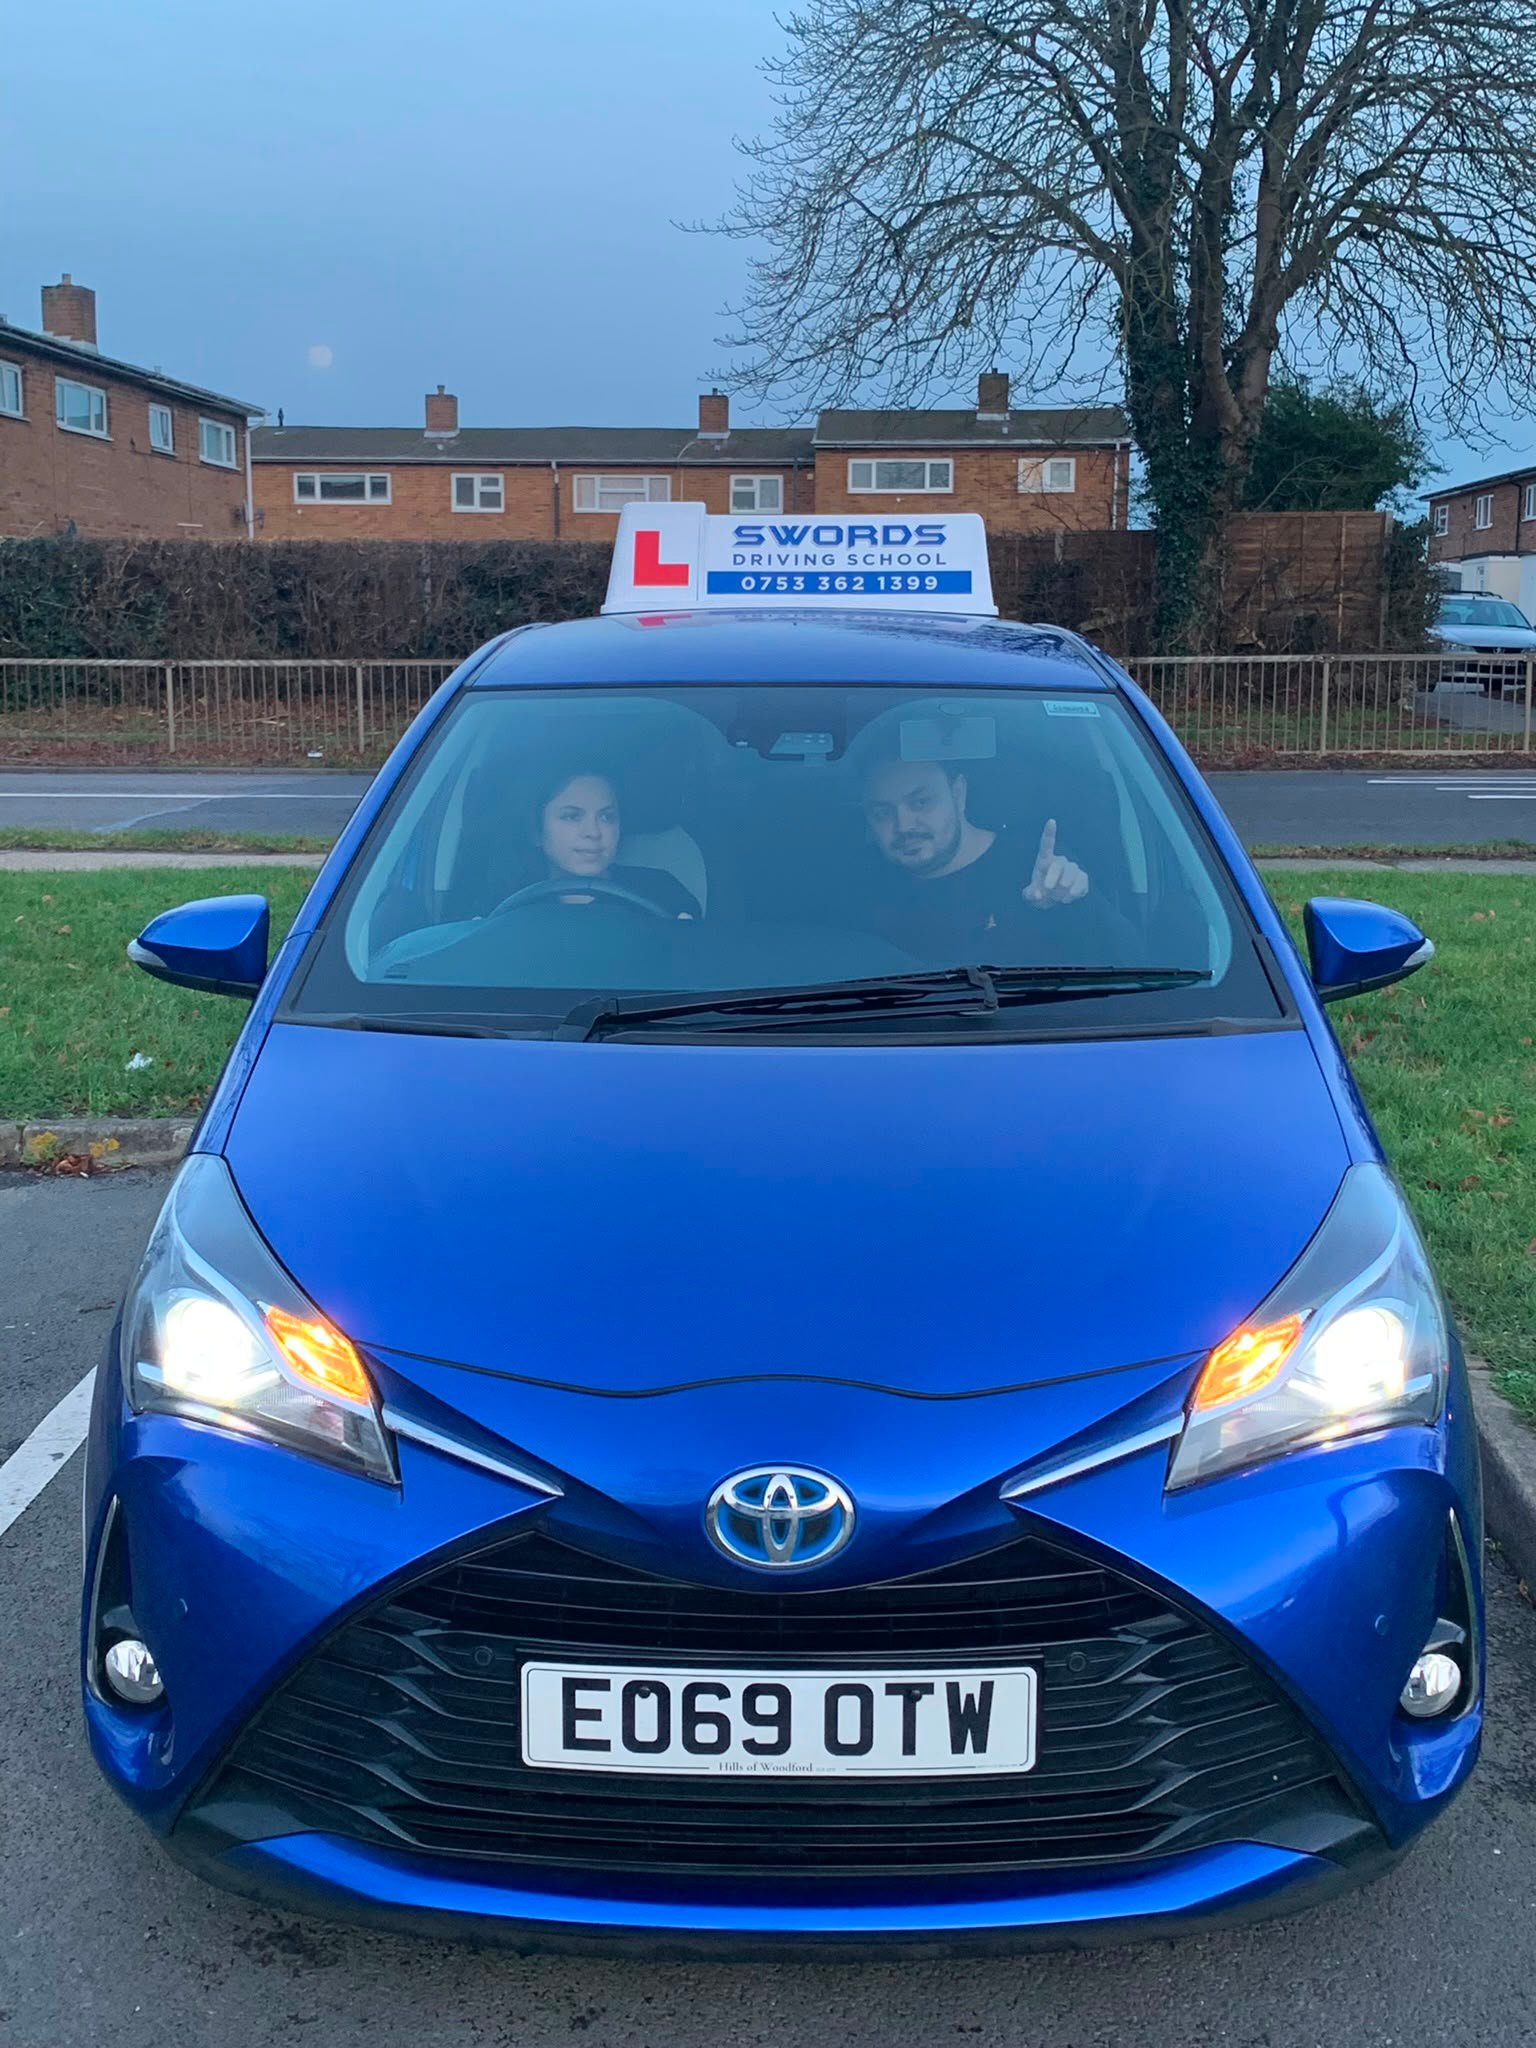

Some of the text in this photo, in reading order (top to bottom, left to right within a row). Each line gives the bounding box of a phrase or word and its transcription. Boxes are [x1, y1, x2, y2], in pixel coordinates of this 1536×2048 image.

[733, 524, 947, 548] SWORDS
[634, 531, 689, 586] L
[733, 553, 946, 567] DRIVING SCHOOL
[741, 576, 939, 591] 0753 362 1399
[562, 1677, 995, 1756] EO69 OTW
[718, 1761, 743, 1772] Hills
[746, 1761, 758, 1772] of
[760, 1762, 813, 1773] Woodford
